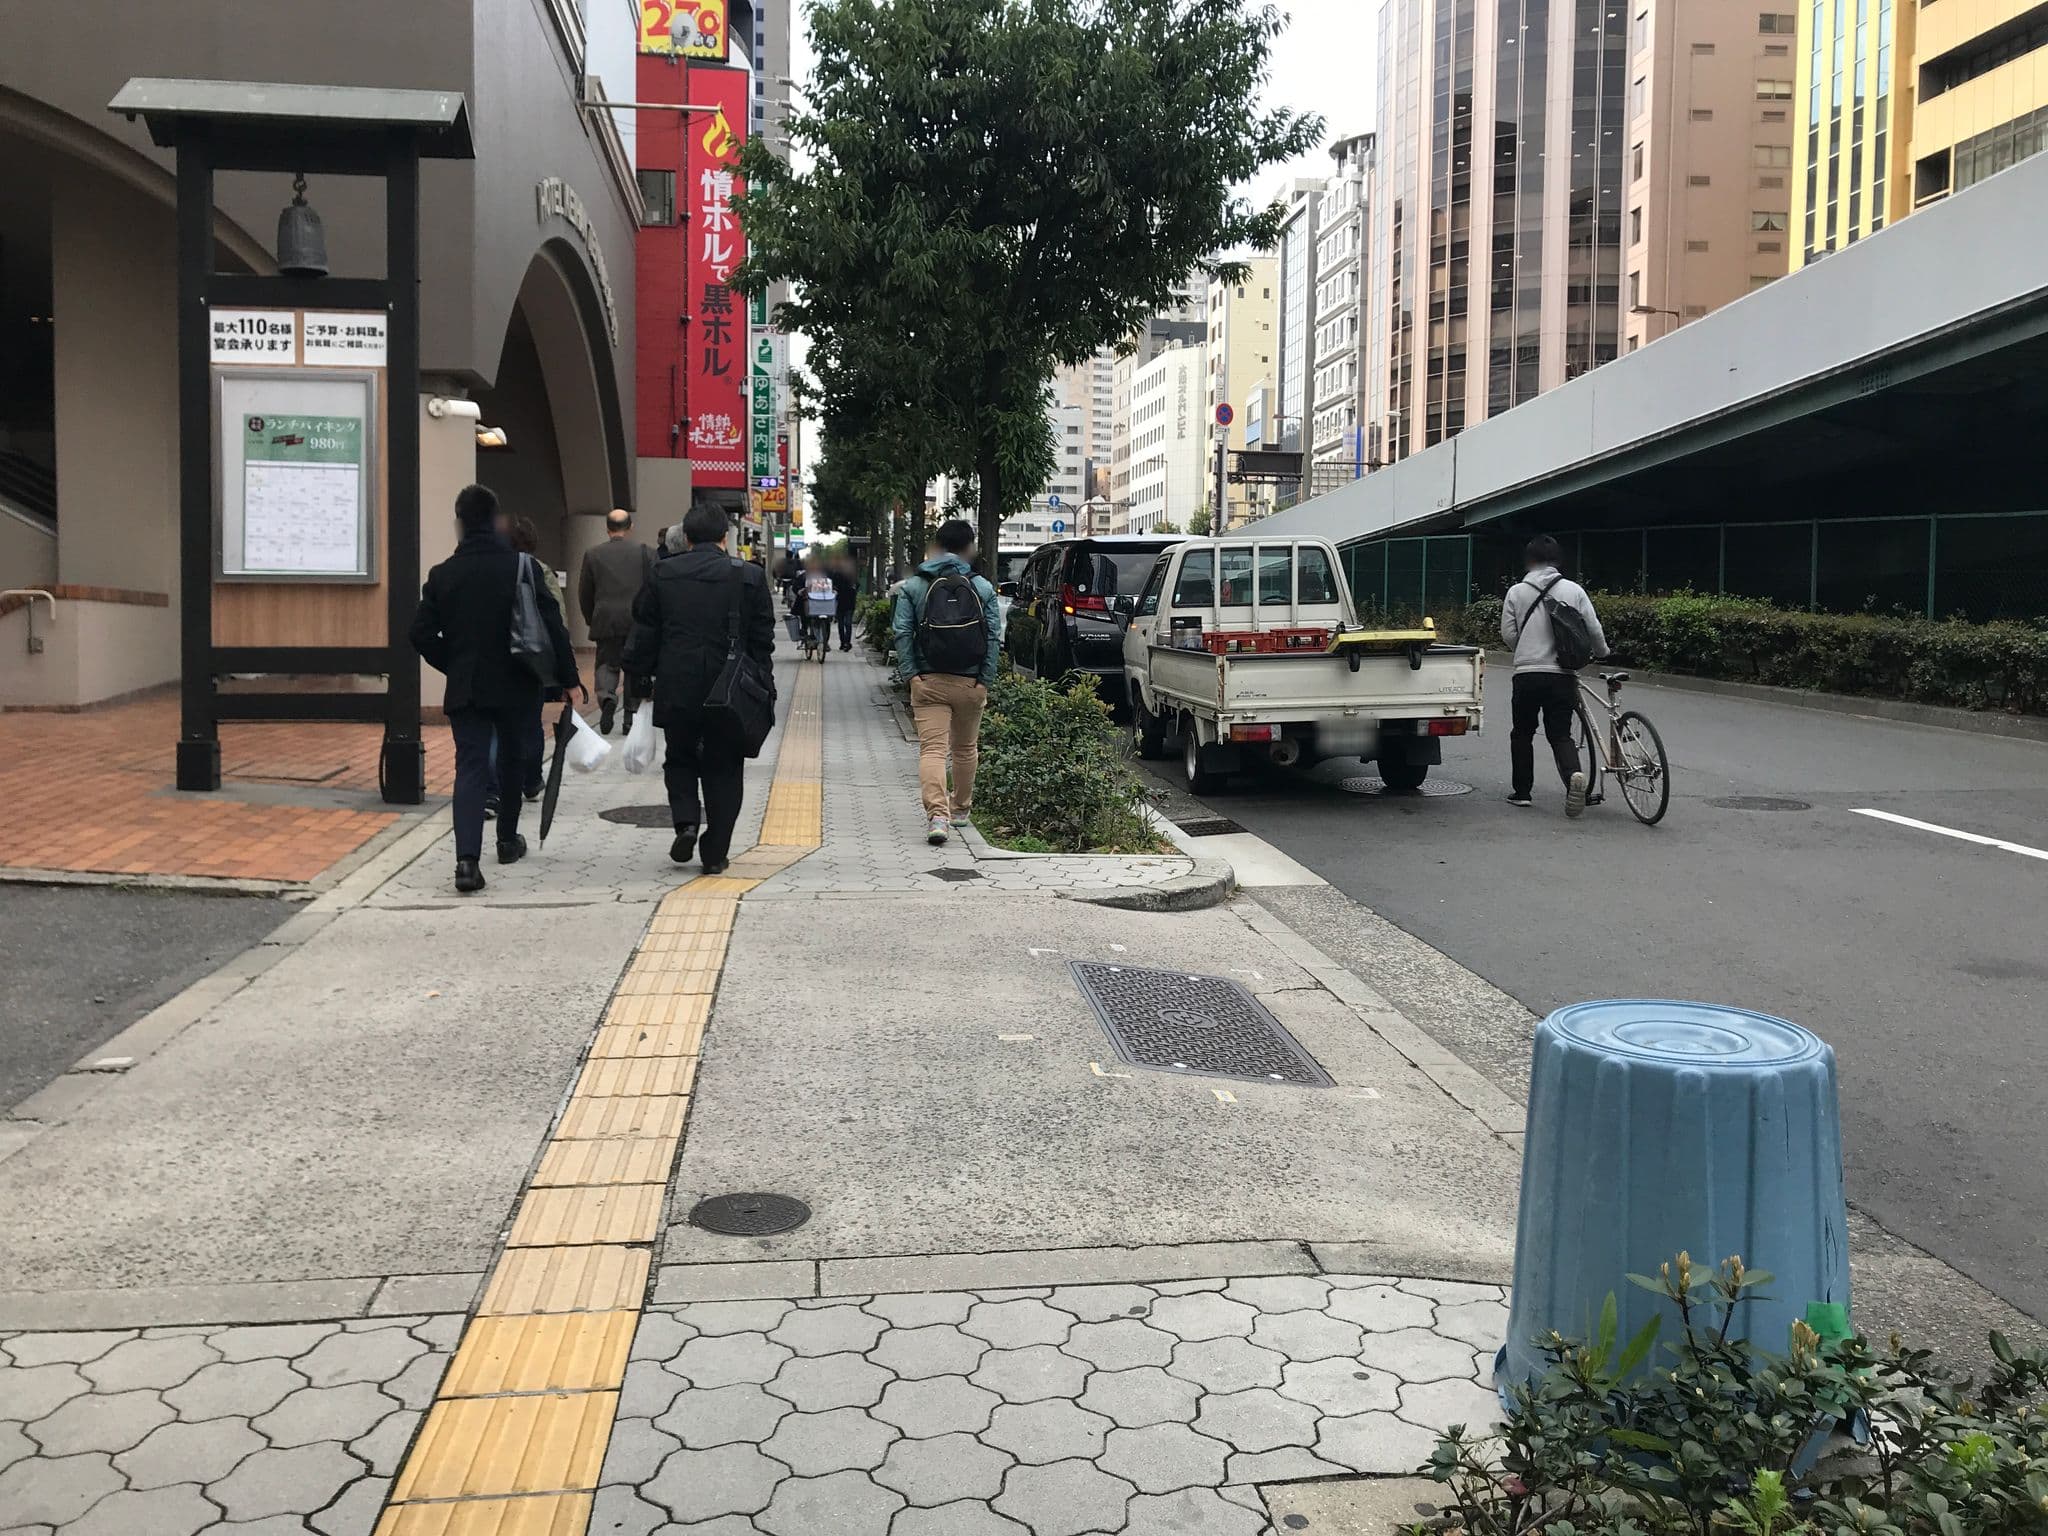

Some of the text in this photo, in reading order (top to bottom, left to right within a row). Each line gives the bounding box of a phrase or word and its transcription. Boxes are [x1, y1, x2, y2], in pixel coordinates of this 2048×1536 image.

[700, 168, 733, 377] 情ホルで黒ホル
[214, 318, 292, 335] 最大110名様
[214, 338, 292, 351] 宴会承ります
[698, 413, 731, 431] 情熱
[689, 427, 742, 444] ホルモン
